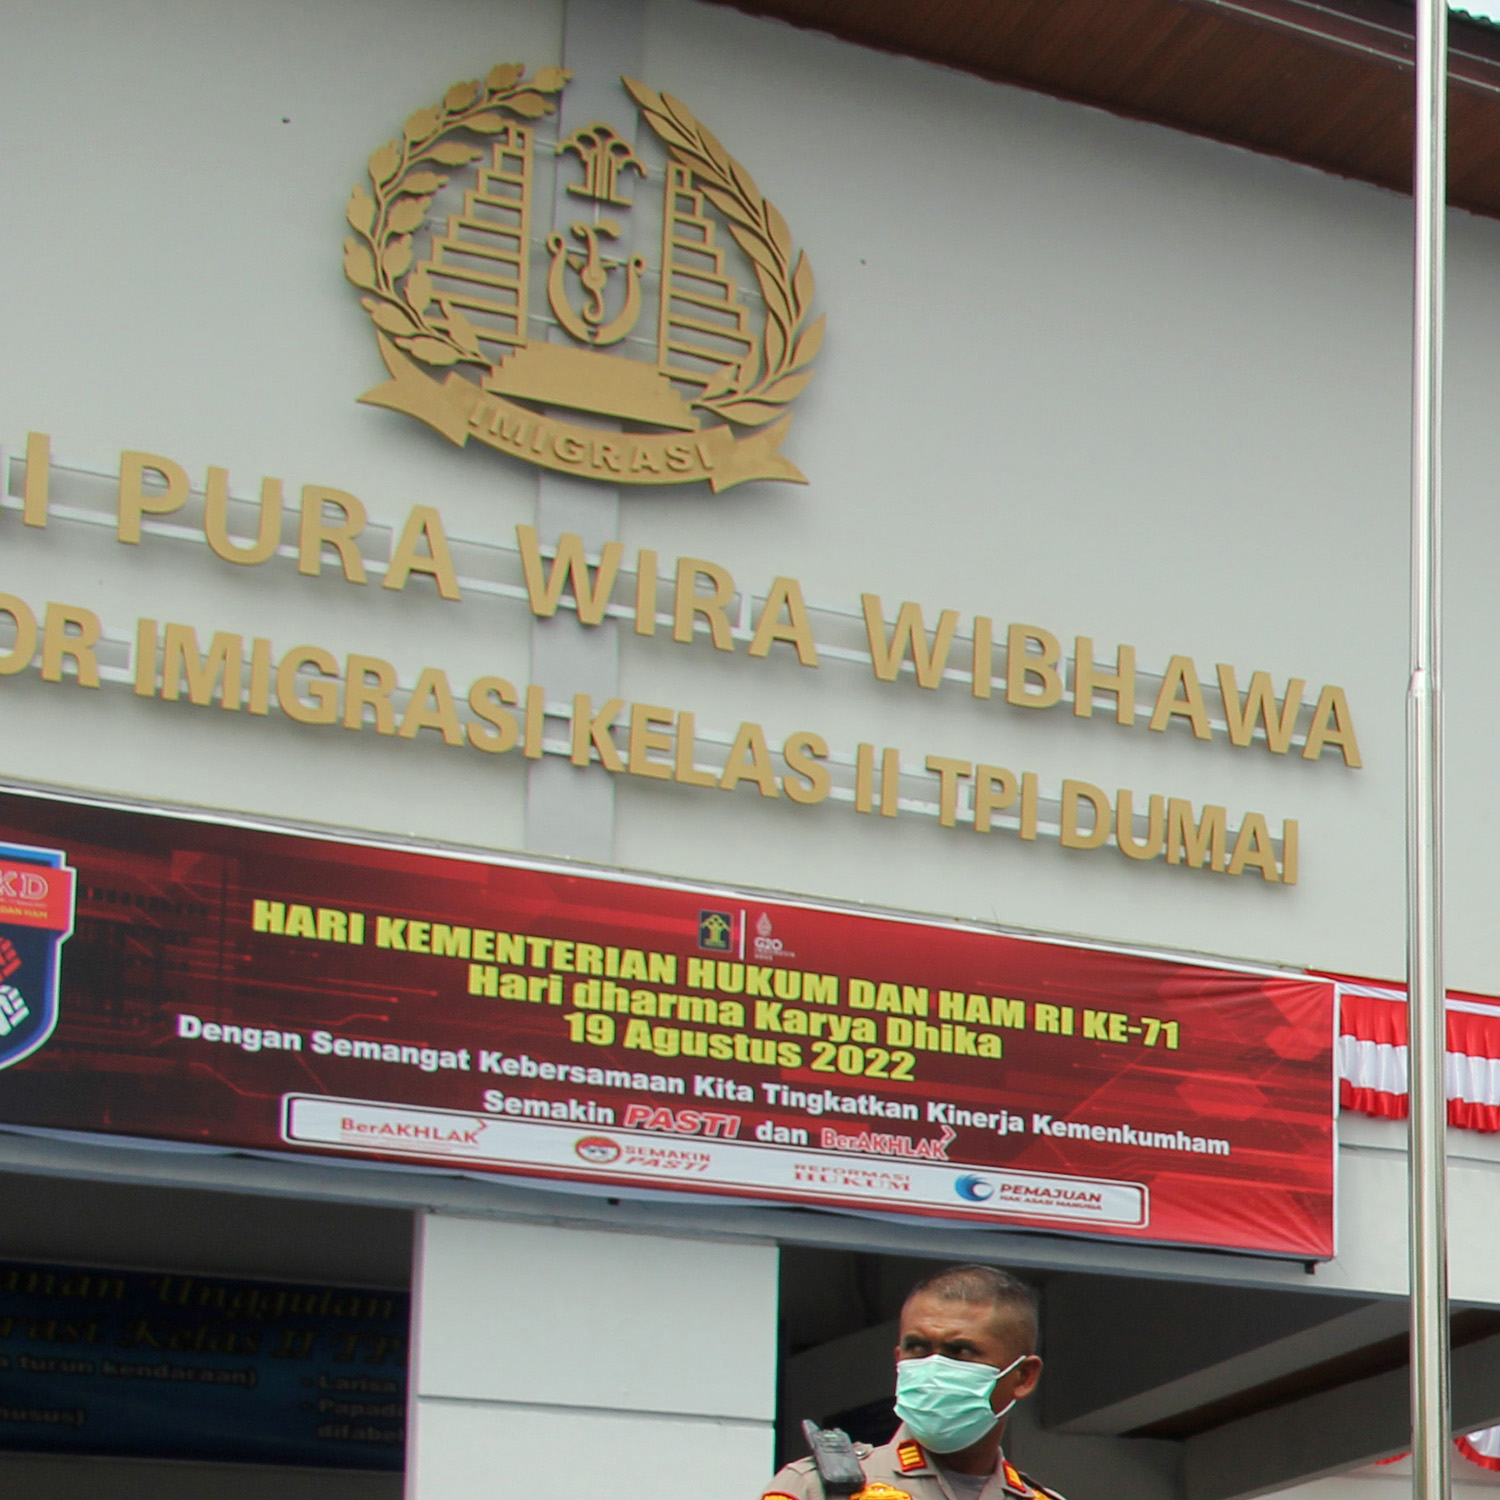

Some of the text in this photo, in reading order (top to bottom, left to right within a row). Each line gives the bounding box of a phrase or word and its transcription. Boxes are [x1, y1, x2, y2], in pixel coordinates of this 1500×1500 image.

[468, 402, 714, 473] IMIGRASI
[117, 450, 461, 600] PURA
[516, 523, 820, 667] WIRA
[861, 593, 1362, 768] WIBHAWA
[134, 617, 545, 760] IMIGRASI
[570, 694, 831, 805] KELAS
[855, 742, 898, 817] II
[925, 755, 1038, 840] TPI
[1060, 779, 1298, 885] DUMAI
[253, 899, 1180, 1050] HARI KEMENTERIAN HUKUM DAN HAM RI KE-71
[469, 964, 1003, 1059] Hari dharma Karya Dhika
[565, 1012, 916, 1082] 19 Agustus 2022
[177, 1013, 1230, 1156] Dengan Semangat Kebersamaan Kita Tingkatkan Kinerja Kemenkumham
[341, 1117, 482, 1144] BerAKHLAK
[484, 1090, 953, 1160] Semakin PASTI dan BerAKHLAK
[625, 1145, 711, 1162] SEMAKIN
[795, 1172, 911, 1192] HUKUM
[1001, 1183, 1102, 1202] PEMAJUAN
